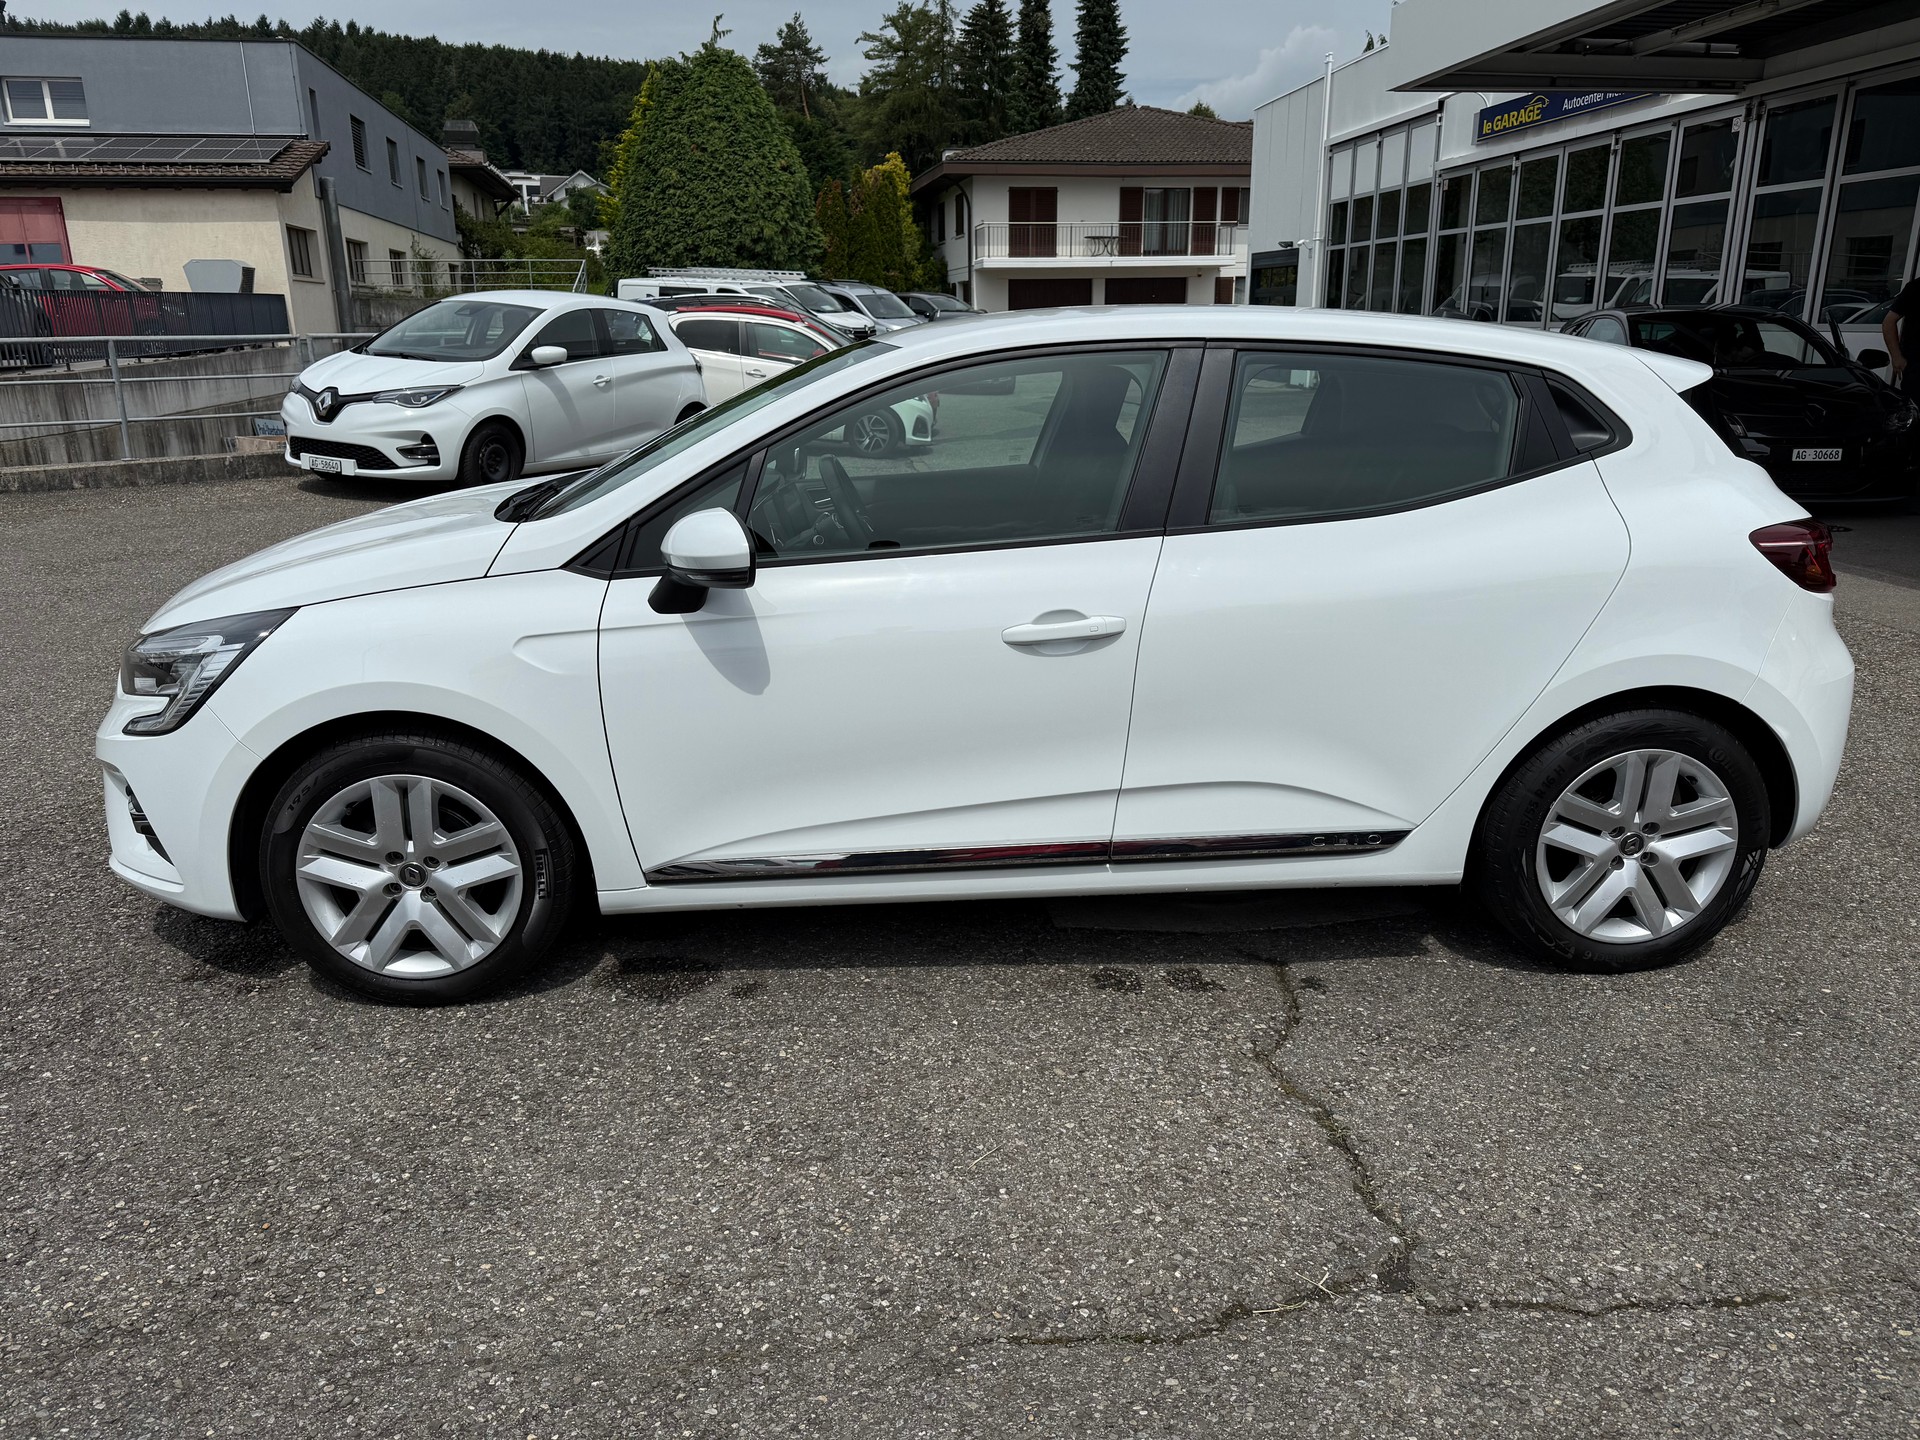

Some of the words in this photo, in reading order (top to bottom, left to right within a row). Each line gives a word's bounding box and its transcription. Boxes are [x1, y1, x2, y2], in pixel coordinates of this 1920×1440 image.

[1562, 92, 1605, 111] Autocenter
[1482, 119, 1492, 134] le
[1493, 104, 1543, 131] GARAGE
[535, 848, 551, 900] PIRELLI
